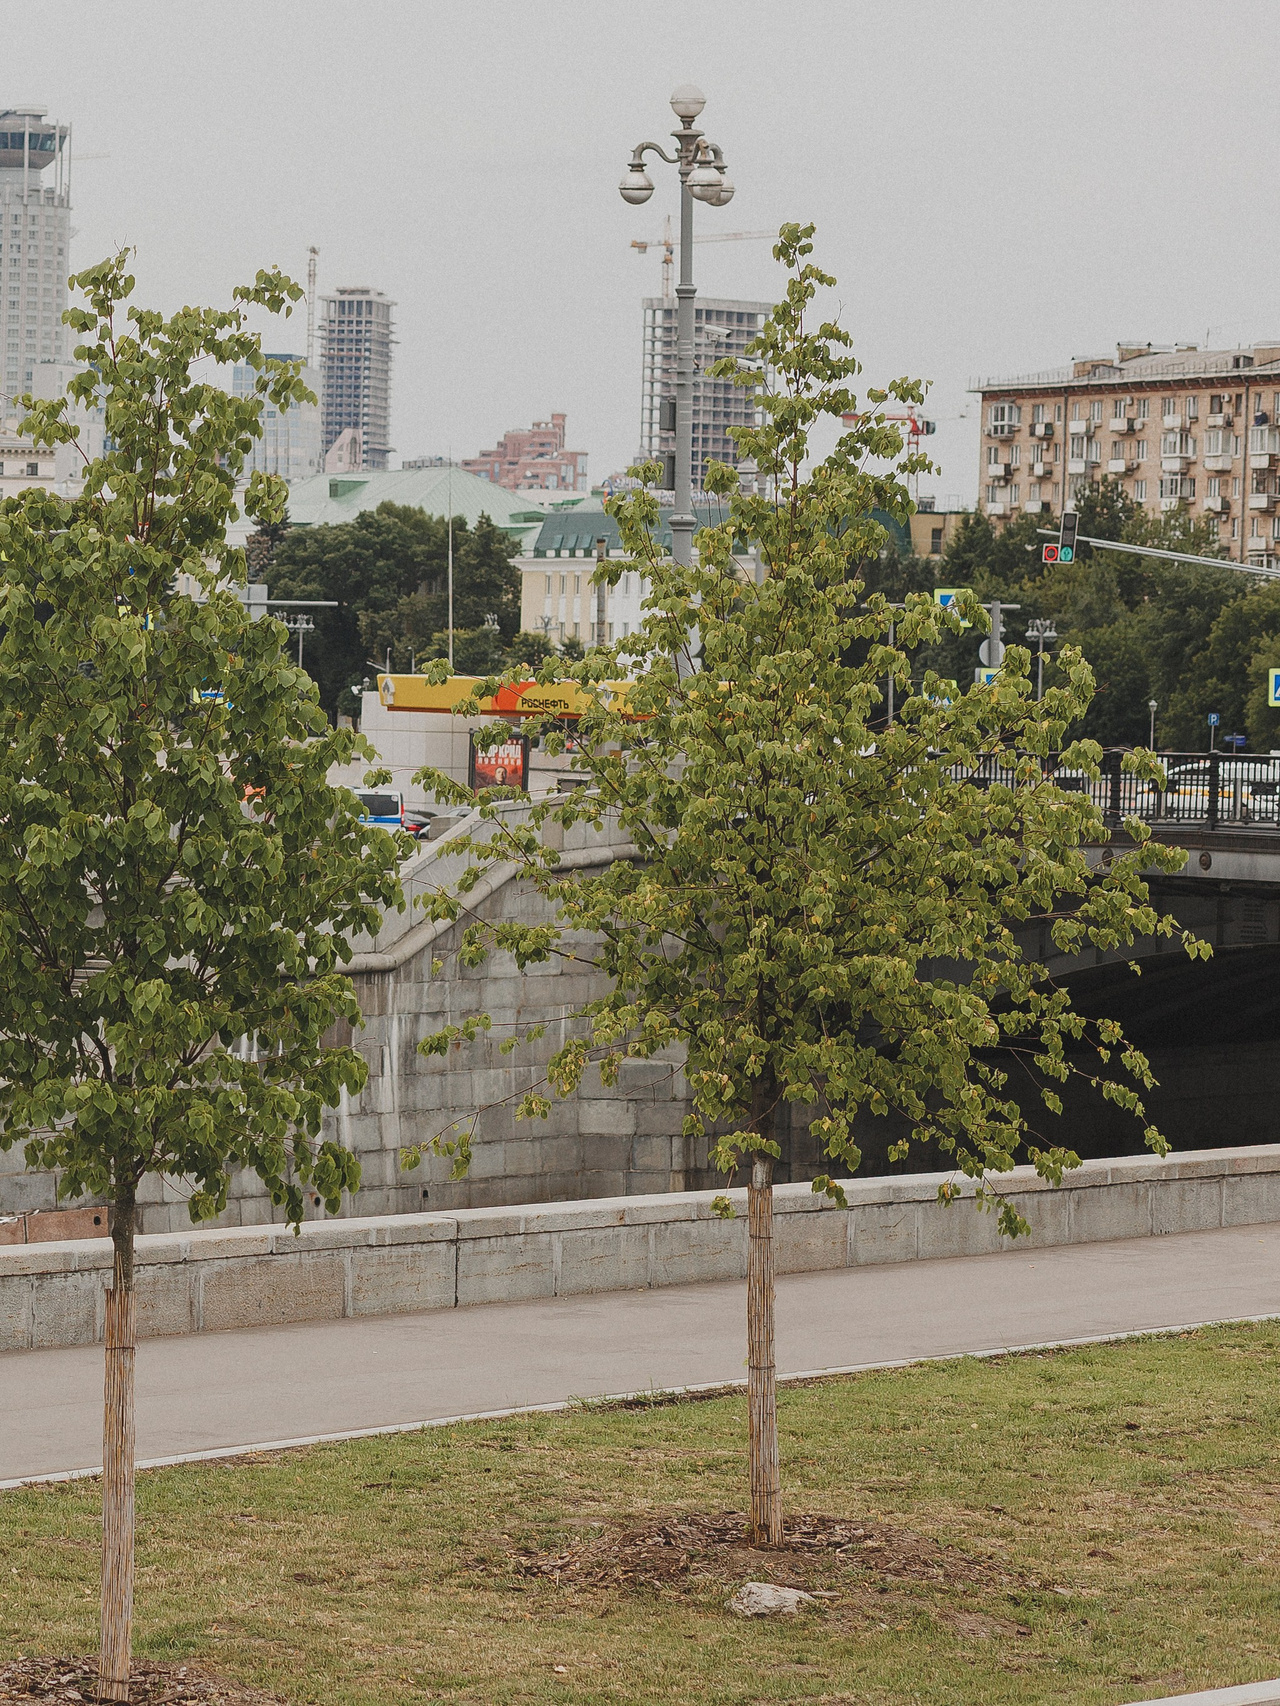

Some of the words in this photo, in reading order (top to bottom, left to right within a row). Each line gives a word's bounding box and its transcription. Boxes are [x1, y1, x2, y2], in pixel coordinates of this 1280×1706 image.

[521, 698, 569, 709] РОСНЕФТЬ
[477, 742, 498, 757] ЕОР
[498, 744, 521, 758] КРИД
